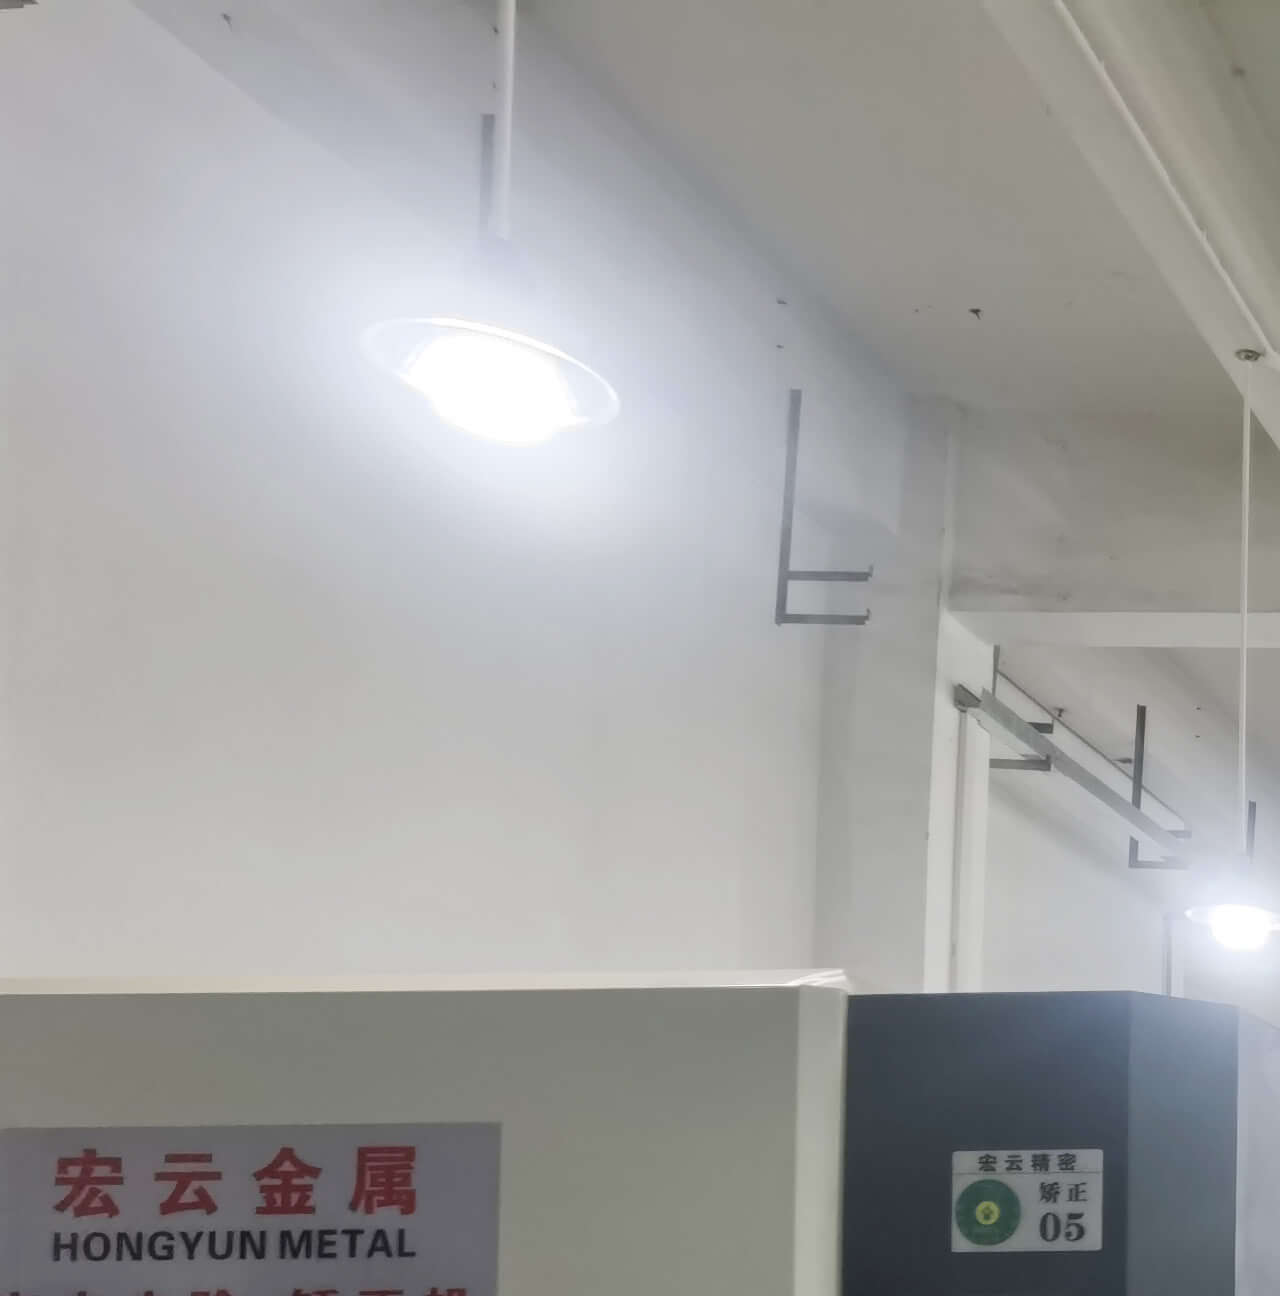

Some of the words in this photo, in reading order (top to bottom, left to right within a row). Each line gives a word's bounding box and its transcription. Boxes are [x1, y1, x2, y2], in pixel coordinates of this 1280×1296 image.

[977, 1153, 1077, 1172] 宏云精密
[53, 1145, 417, 1218] 宏云金属
[1039, 1181, 1088, 1203] 矫正
[1039, 1212, 1086, 1242] 05
[53, 1230, 267, 1262] HONGYUN
[279, 1228, 417, 1259] METAL
